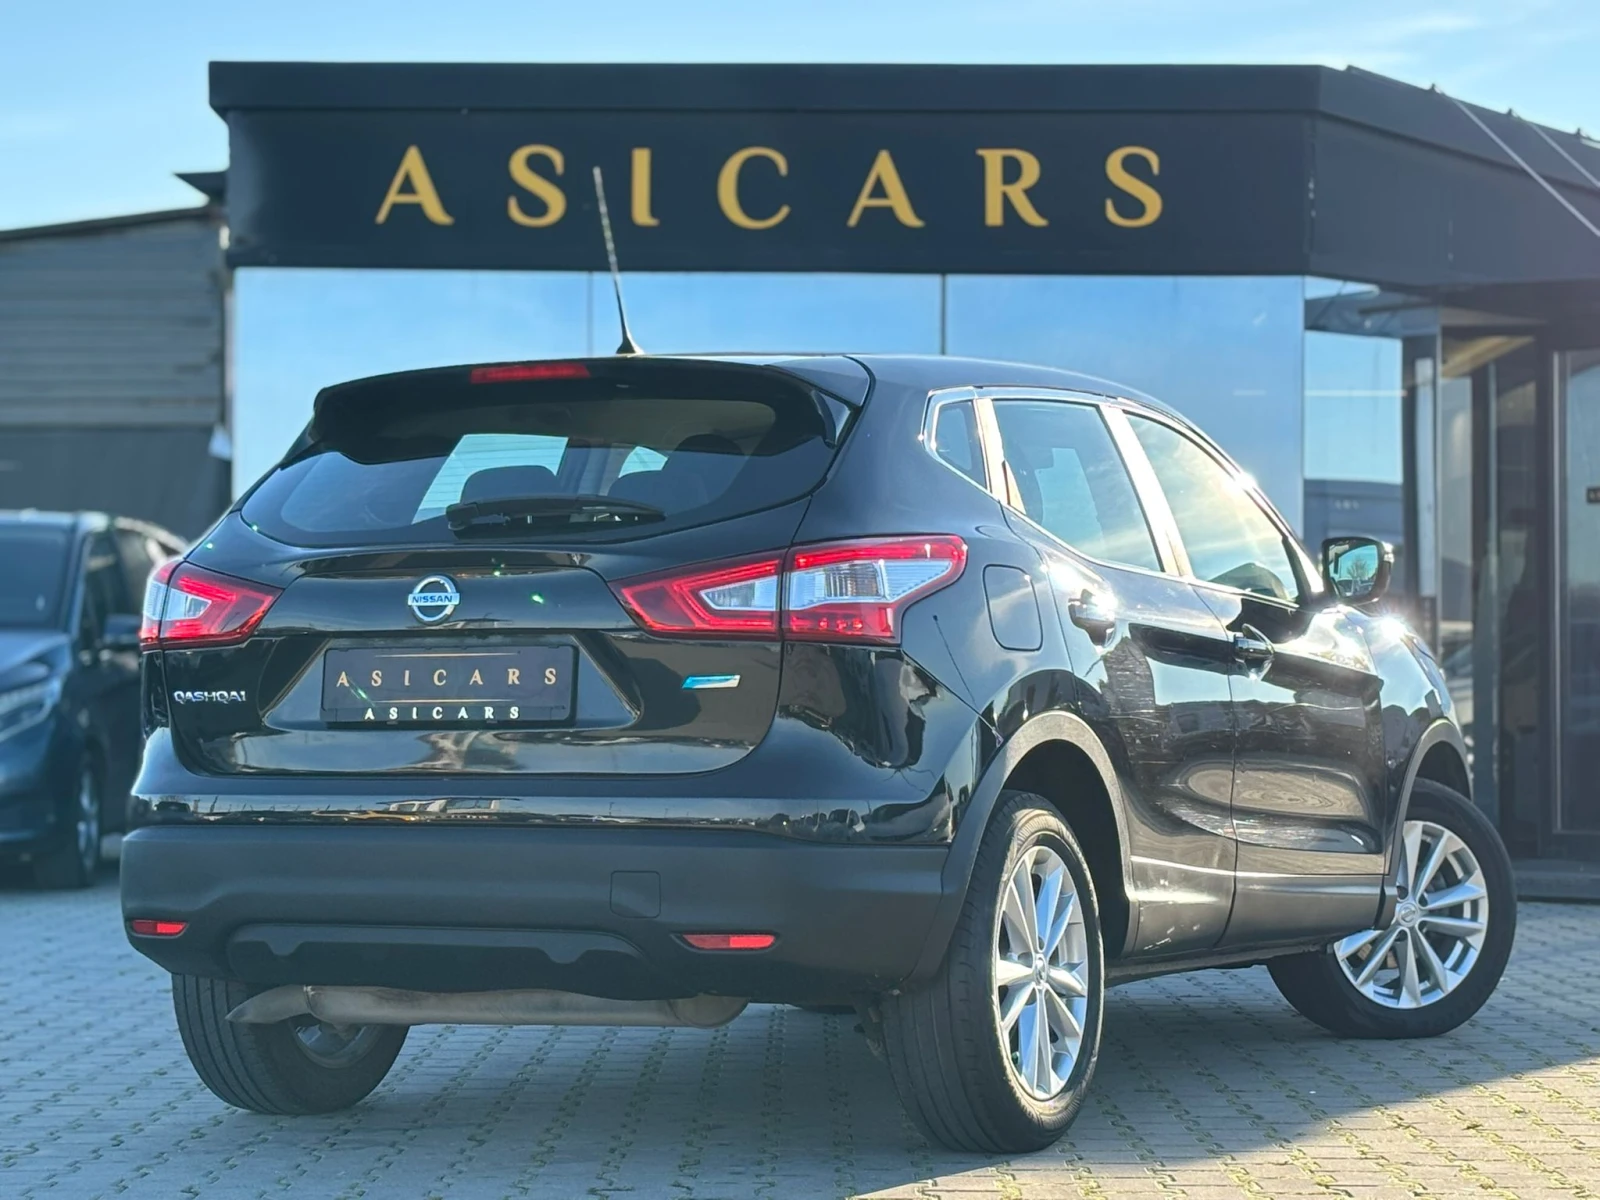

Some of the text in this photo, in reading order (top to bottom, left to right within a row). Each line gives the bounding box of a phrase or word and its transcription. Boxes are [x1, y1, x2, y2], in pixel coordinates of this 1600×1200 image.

[375, 144, 1164, 230] ASICARS
[412, 595, 453, 603] NISSAN
[336, 668, 557, 688] ASICARS
[173, 690, 246, 704] QASHQAI
[364, 706, 520, 720] ASICARS
